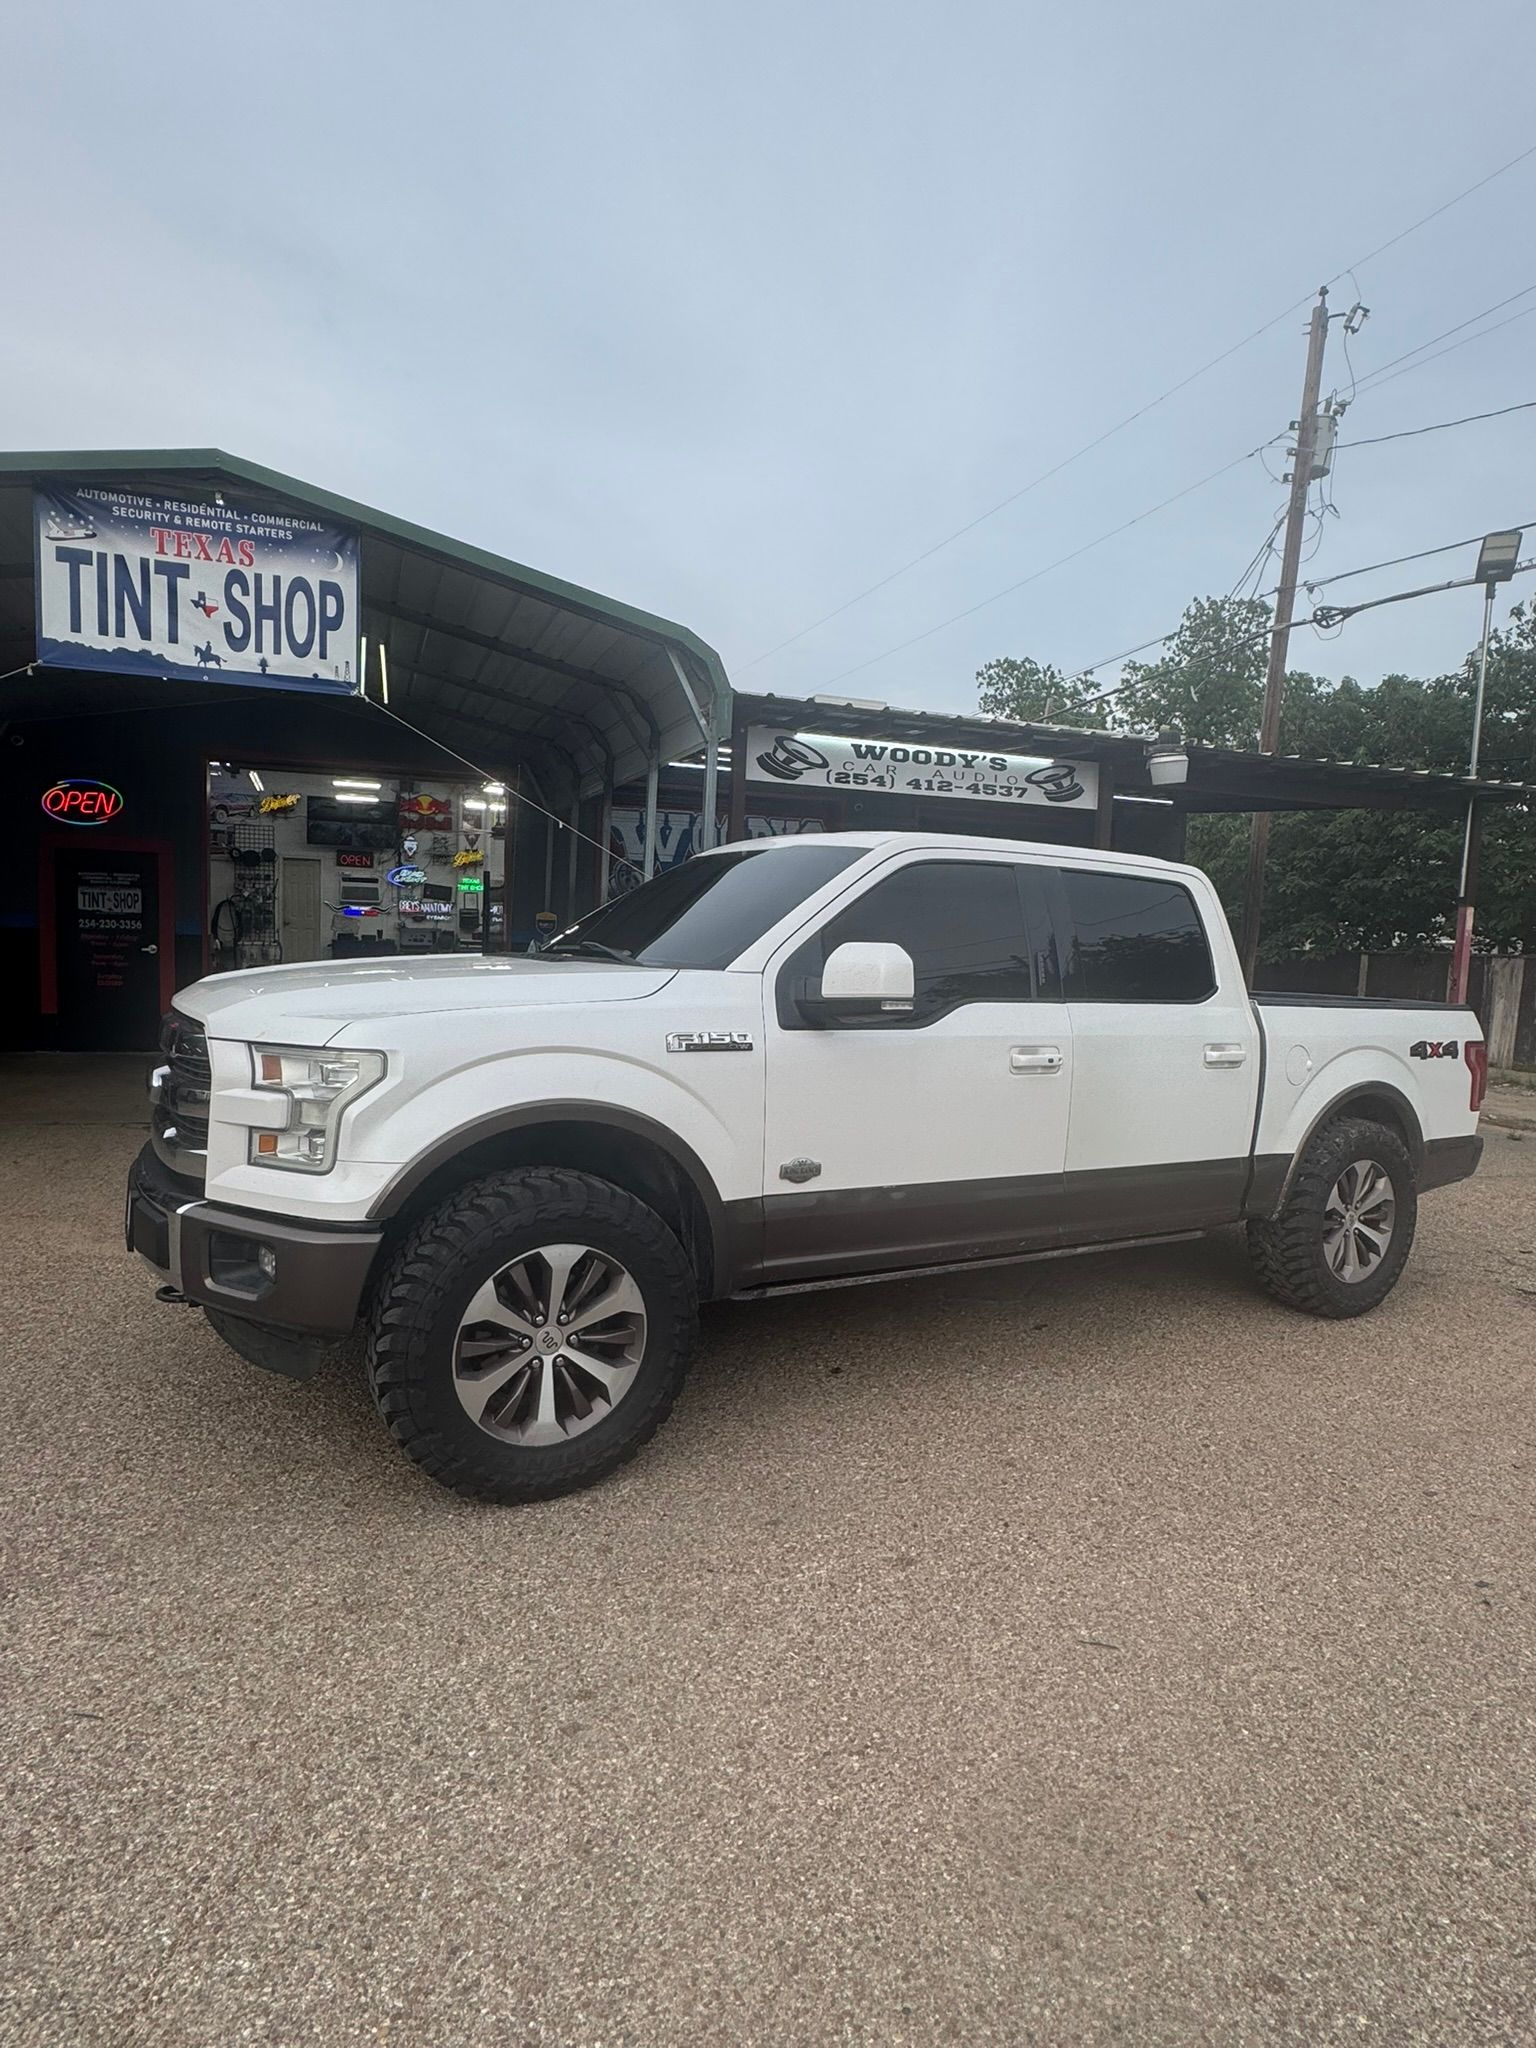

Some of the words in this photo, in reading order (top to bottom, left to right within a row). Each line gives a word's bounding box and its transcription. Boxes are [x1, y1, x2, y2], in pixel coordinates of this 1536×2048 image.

[76, 488, 152, 507] AUTOMOTIVE
[164, 500, 241, 521] RESIDENTIAL
[251, 513, 325, 532] COMMERCIAL
[112, 506, 171, 523] SECURITY
[174, 515, 182, 524] &
[185, 517, 233, 532] REMOTE
[236, 524, 293, 540] STARTERS
[150, 527, 256, 567] TEXAS
[55, 545, 190, 645] TINT
[223, 568, 345, 661] SHOP
[850, 743, 1008, 772] WOODY'S
[826, 769, 896, 790] (254)
[906, 777, 1029, 799] 412-4537
[843, 761, 897, 775] CAR
[932, 769, 1019, 785] AUDIO
[46, 790, 116, 814] OPEN
[340, 854, 371, 866] OPEN
[80, 891, 107, 908] TINT
[113, 892, 139, 909] SHOP
[78, 918, 143, 929] 254-230-3356
